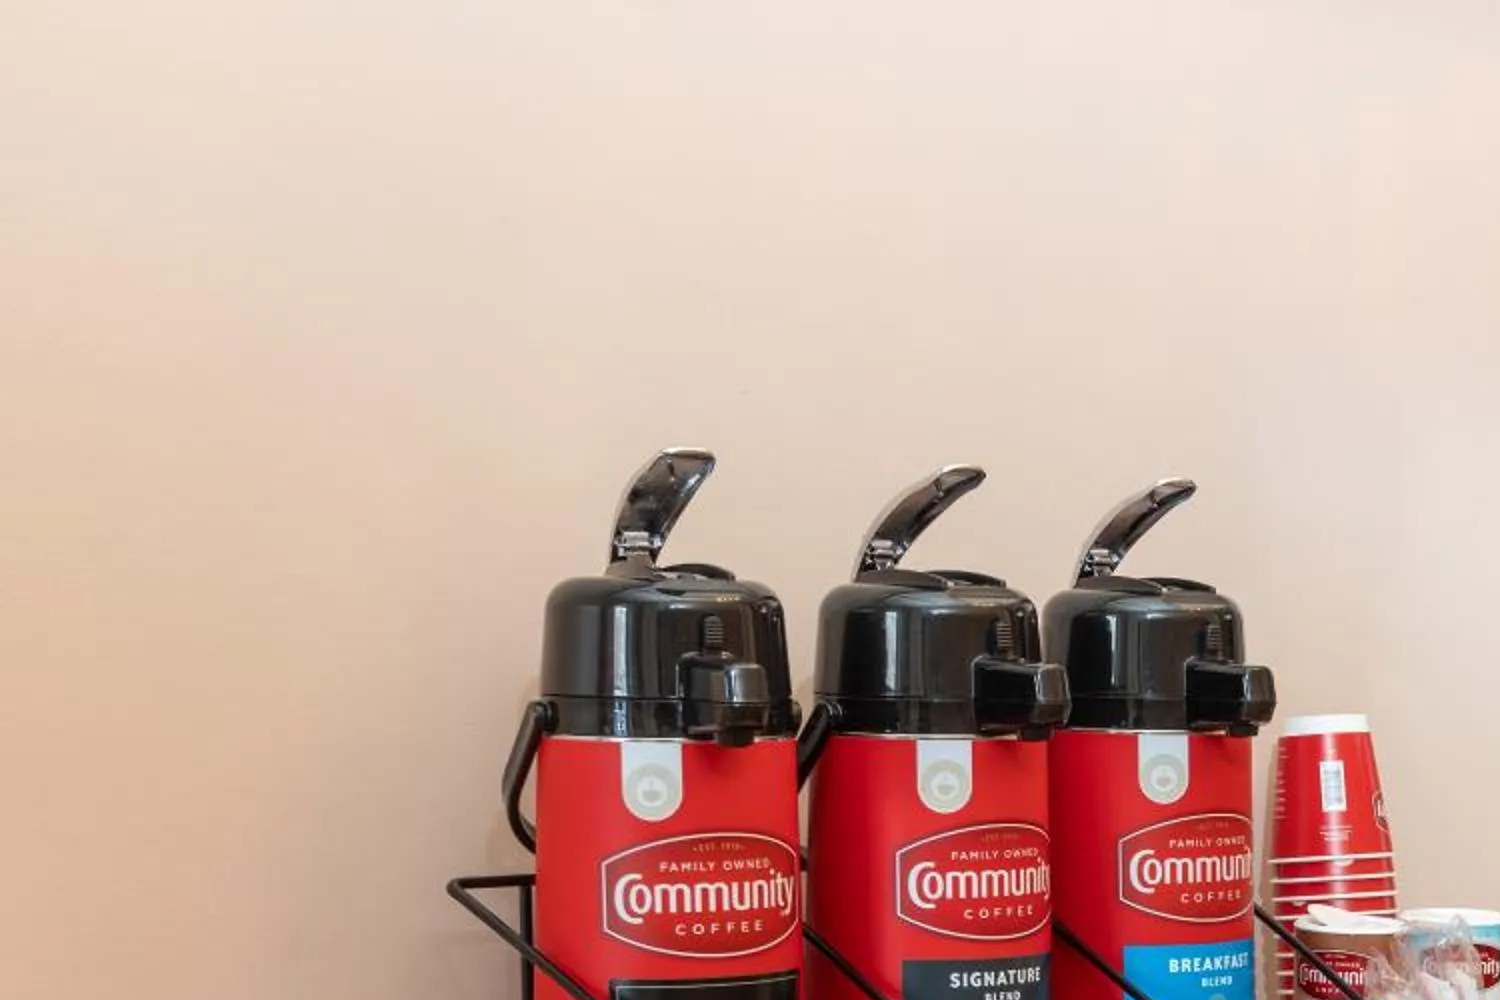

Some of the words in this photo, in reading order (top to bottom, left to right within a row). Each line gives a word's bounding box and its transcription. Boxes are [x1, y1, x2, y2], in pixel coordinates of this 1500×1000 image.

[951, 850, 999, 861] FAMILY
[660, 861, 716, 873] FAMILY
[723, 857, 771, 871] OWNED
[613, 868, 795, 925] Community
[1180, 889, 1242, 903] COFFEE
[963, 904, 1033, 920] COFFEE
[675, 920, 763, 936] COFFEE
[1168, 952, 1248, 973] BREAKFAST
[949, 966, 1041, 988] SIGNATURE
[1201, 976, 1233, 987] BLEND
